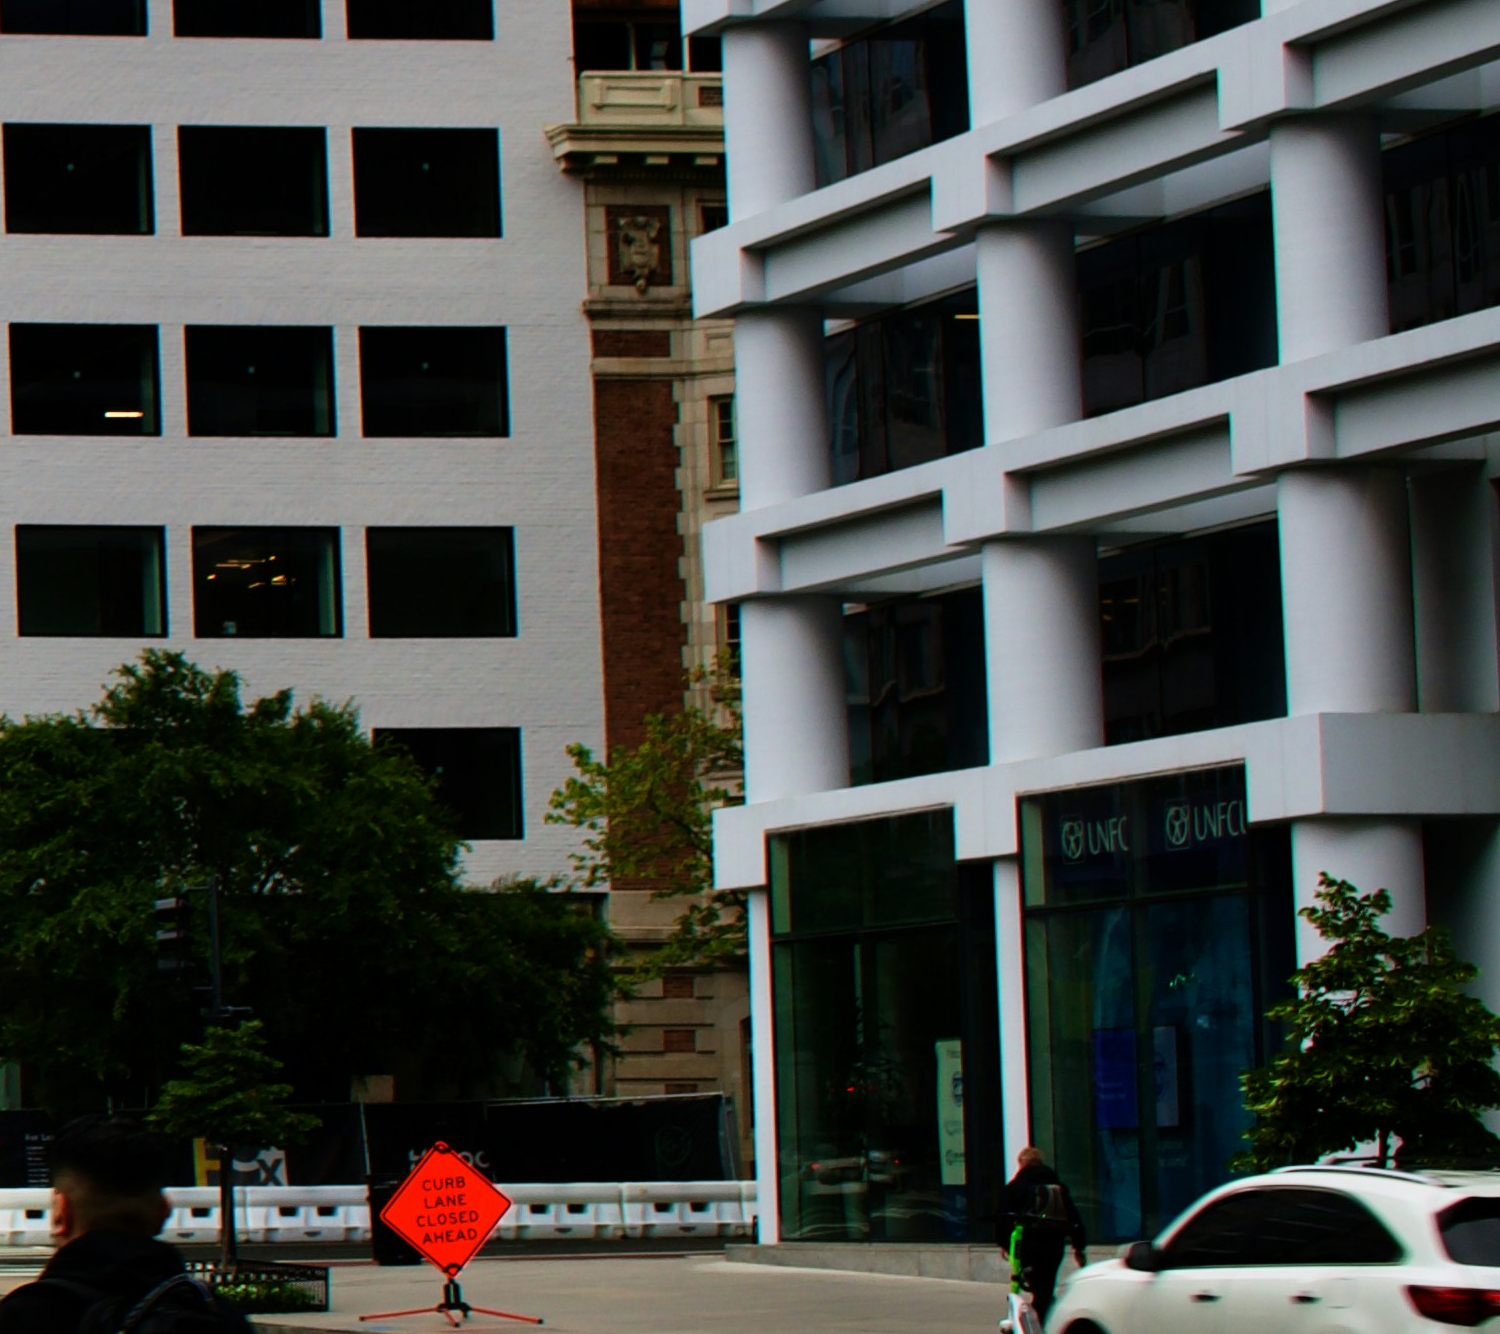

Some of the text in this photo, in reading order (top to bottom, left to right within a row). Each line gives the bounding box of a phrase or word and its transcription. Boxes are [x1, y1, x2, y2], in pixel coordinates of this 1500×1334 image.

[1086, 815, 1130, 856] UNFC
[421, 1176, 466, 1192] CURB
[424, 1194, 468, 1210] LANE
[416, 1210, 479, 1228] CLOSED
[422, 1228, 478, 1245] AHEAD
